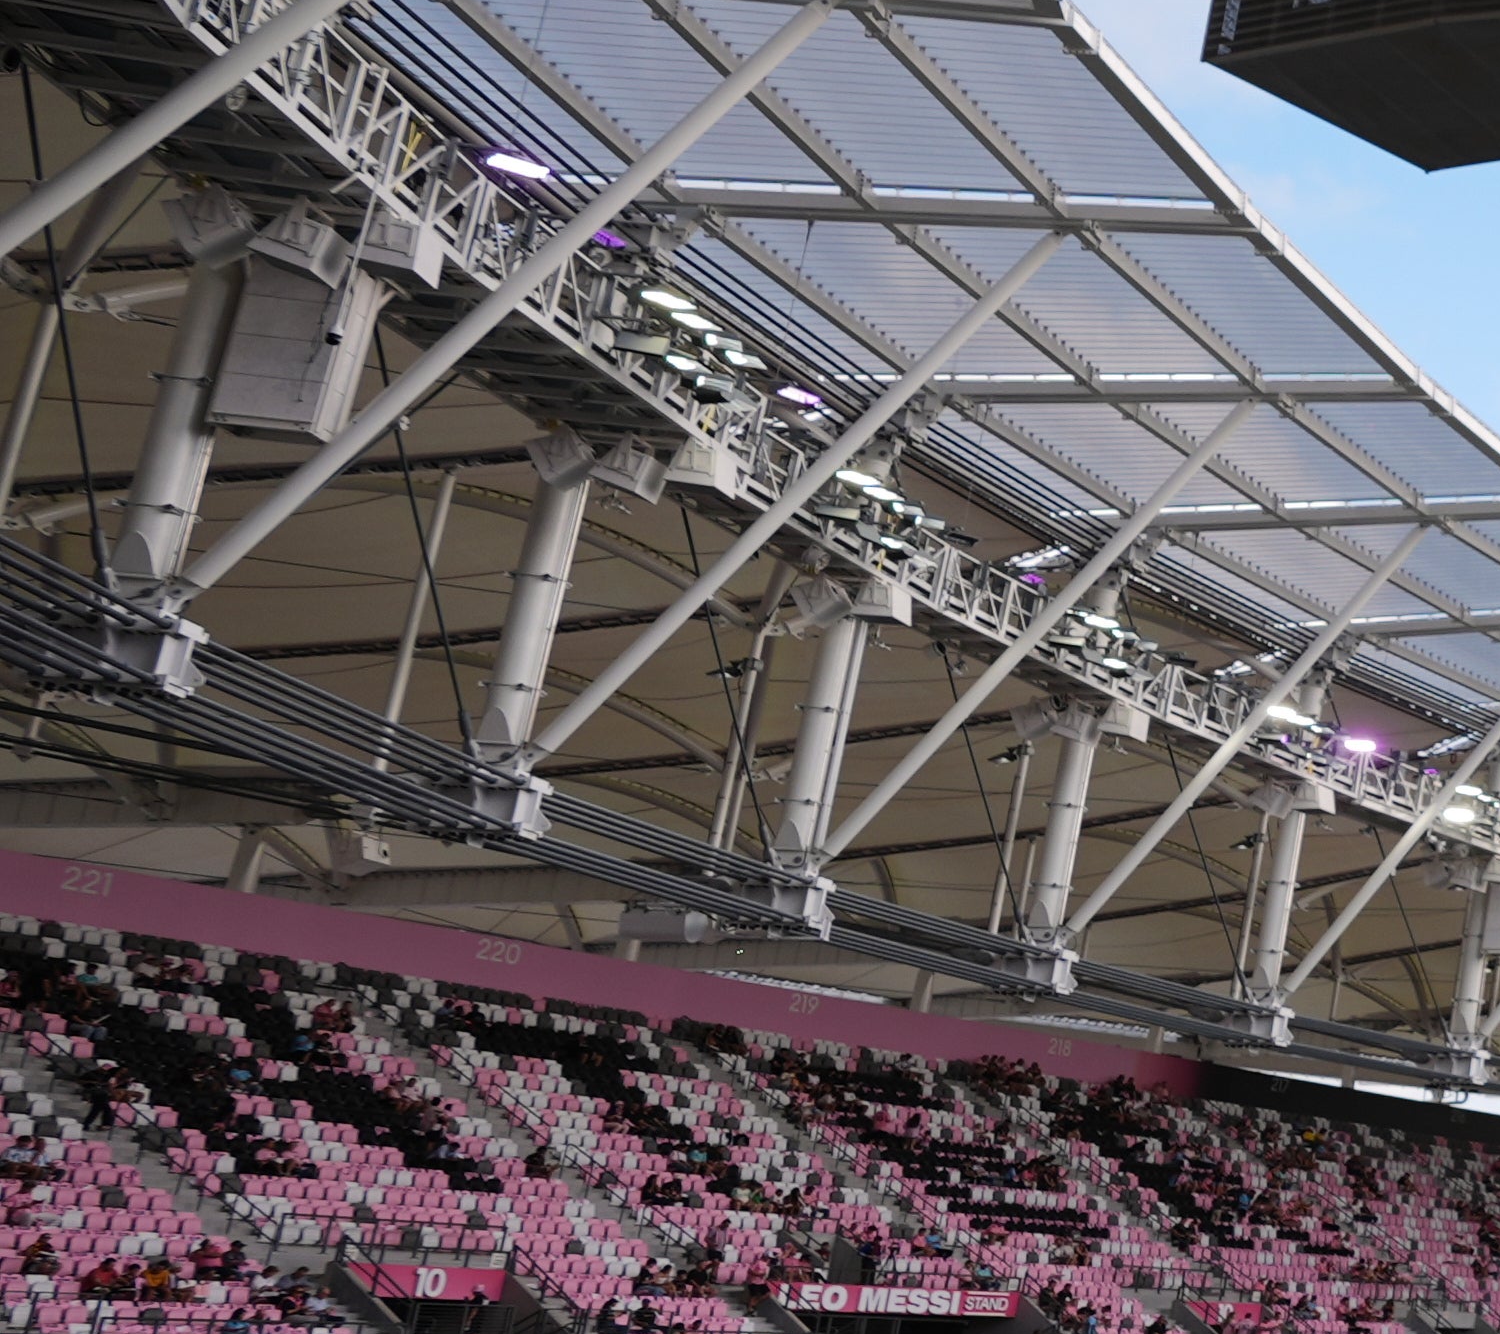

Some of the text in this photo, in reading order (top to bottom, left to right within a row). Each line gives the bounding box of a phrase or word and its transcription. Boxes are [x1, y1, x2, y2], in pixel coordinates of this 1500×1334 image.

[61, 865, 113, 898] 221
[475, 937, 522, 966] 220
[789, 995, 819, 1016] 219
[1048, 1038, 1071, 1057] 218
[413, 1267, 447, 1298] 10
[779, 1282, 1010, 1317] LEO MESSI STAND
